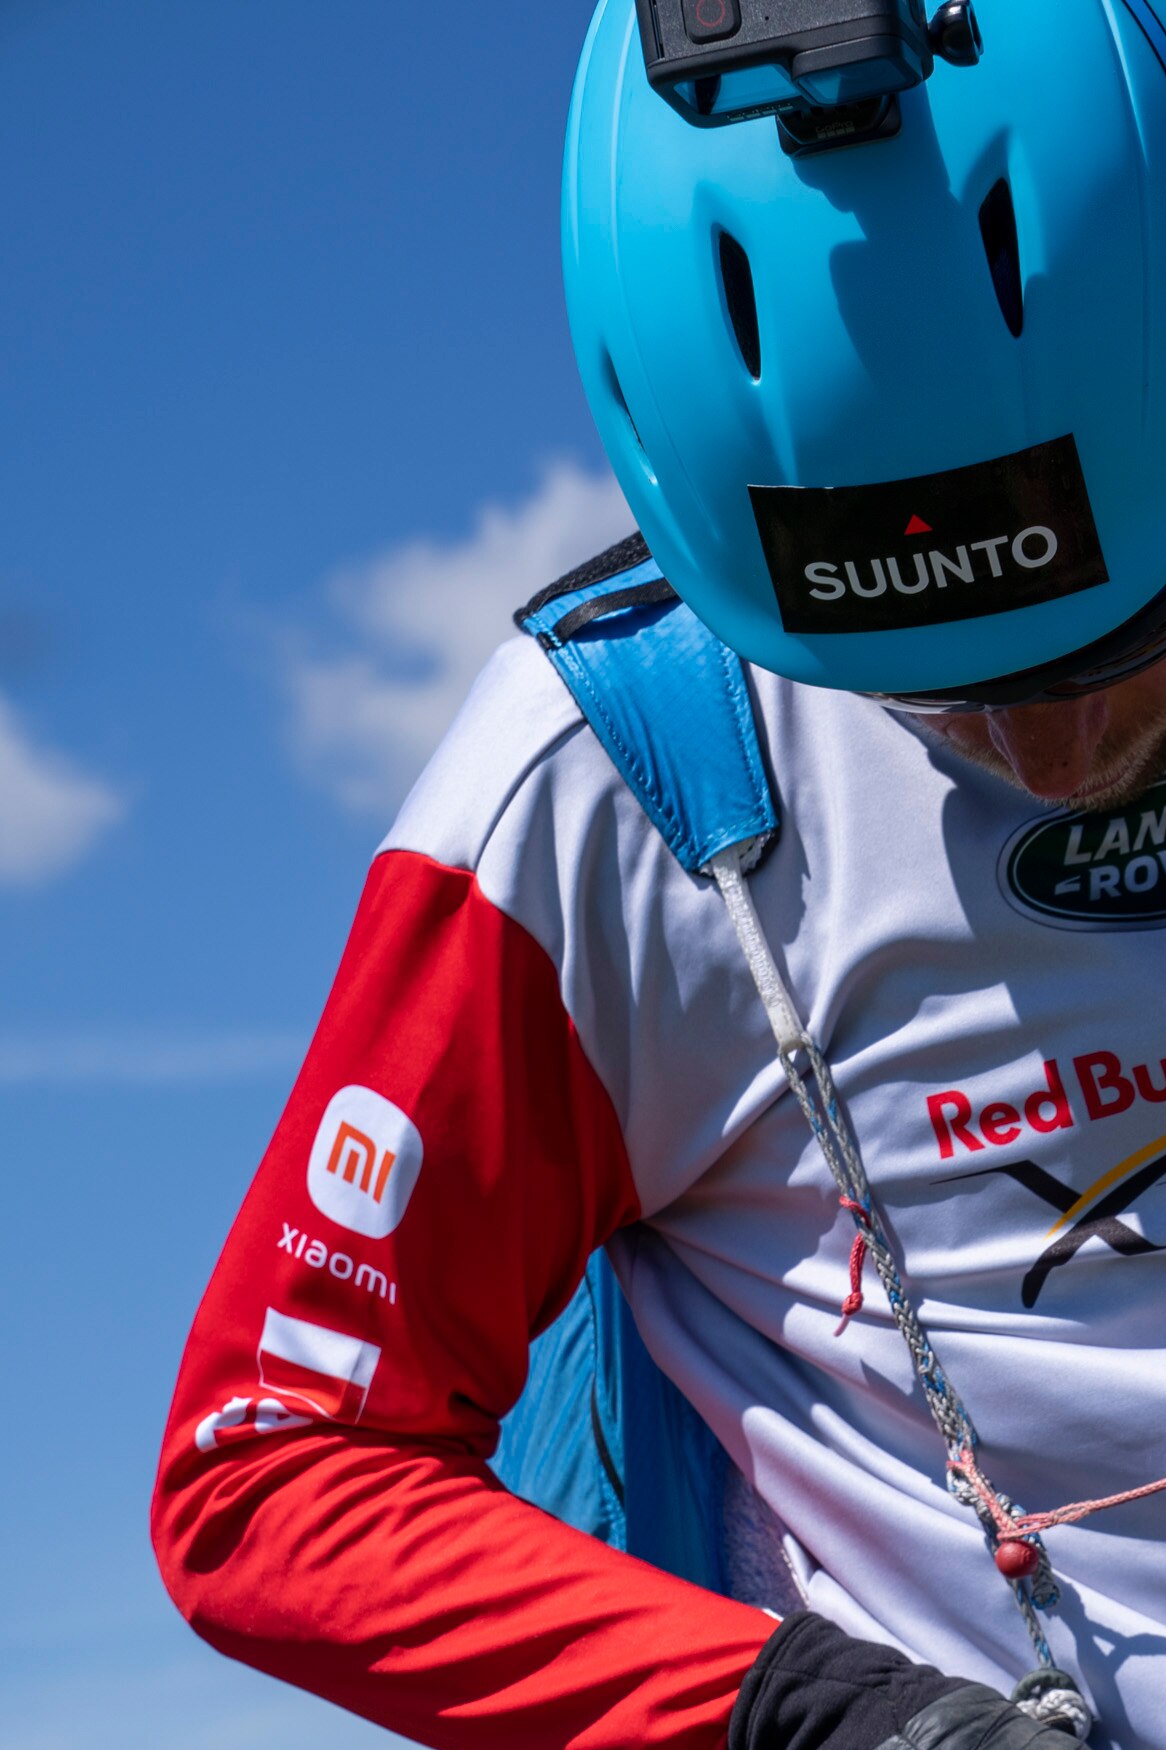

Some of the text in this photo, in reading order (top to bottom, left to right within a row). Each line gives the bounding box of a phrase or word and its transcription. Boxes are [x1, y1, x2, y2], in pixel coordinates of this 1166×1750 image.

[803, 524, 1059, 602] SUUNTO
[925, 1059, 1074, 1160] Red
[277, 1222, 397, 1306] xiaomi
